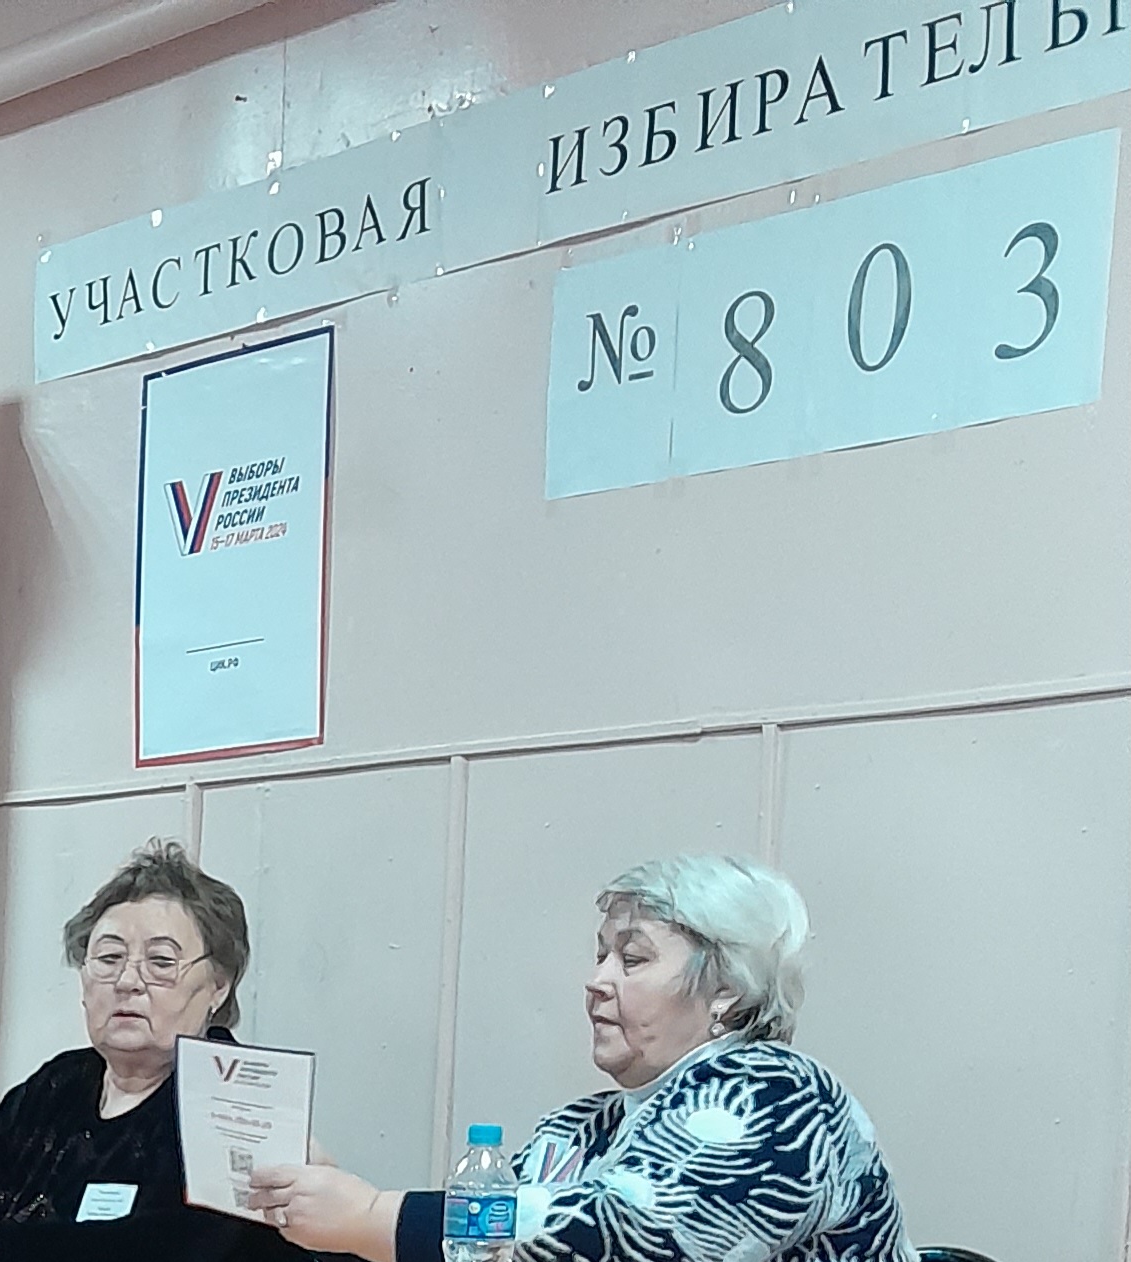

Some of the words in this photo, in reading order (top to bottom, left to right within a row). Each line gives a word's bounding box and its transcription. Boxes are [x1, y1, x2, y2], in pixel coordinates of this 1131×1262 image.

[49, 176, 433, 340] УЧАСТКОВАЯ
[545, 0, 1131, 195] ИЗБИРАТЕЛЬ
[577, 304, 657, 393] №
[228, 456, 286, 485] ВЫБОРЫ
[221, 475, 301, 507] ПРЕЗИДЕНТА
[214, 505, 267, 531] РОССИИ
[233, 526, 266, 545] МАРТА
[264, 522, 288, 540] 2024
